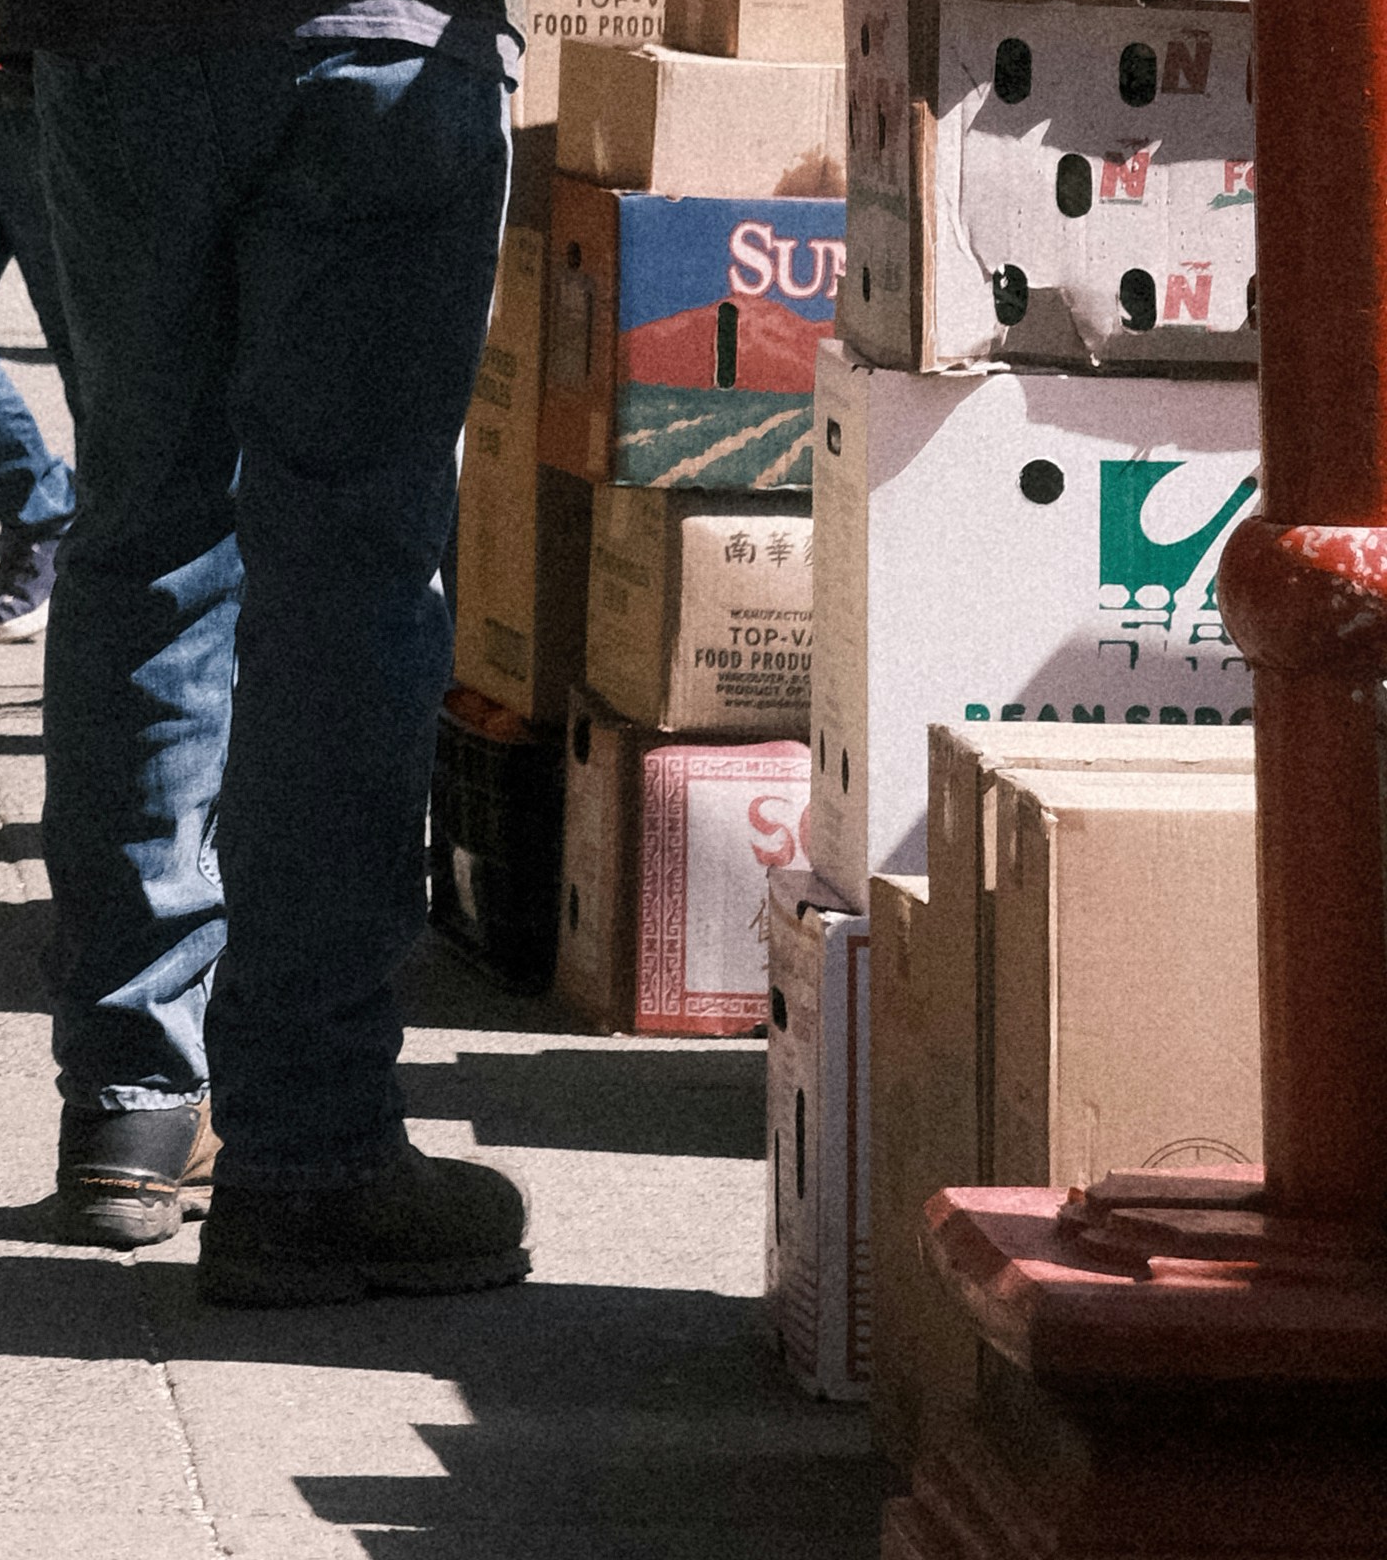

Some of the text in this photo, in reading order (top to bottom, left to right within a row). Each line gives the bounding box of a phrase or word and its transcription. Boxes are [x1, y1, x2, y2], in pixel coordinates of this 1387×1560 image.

[533, 14, 588, 36] FOOD
[694, 648, 743, 669] FOOD
[748, 795, 811, 868] S
